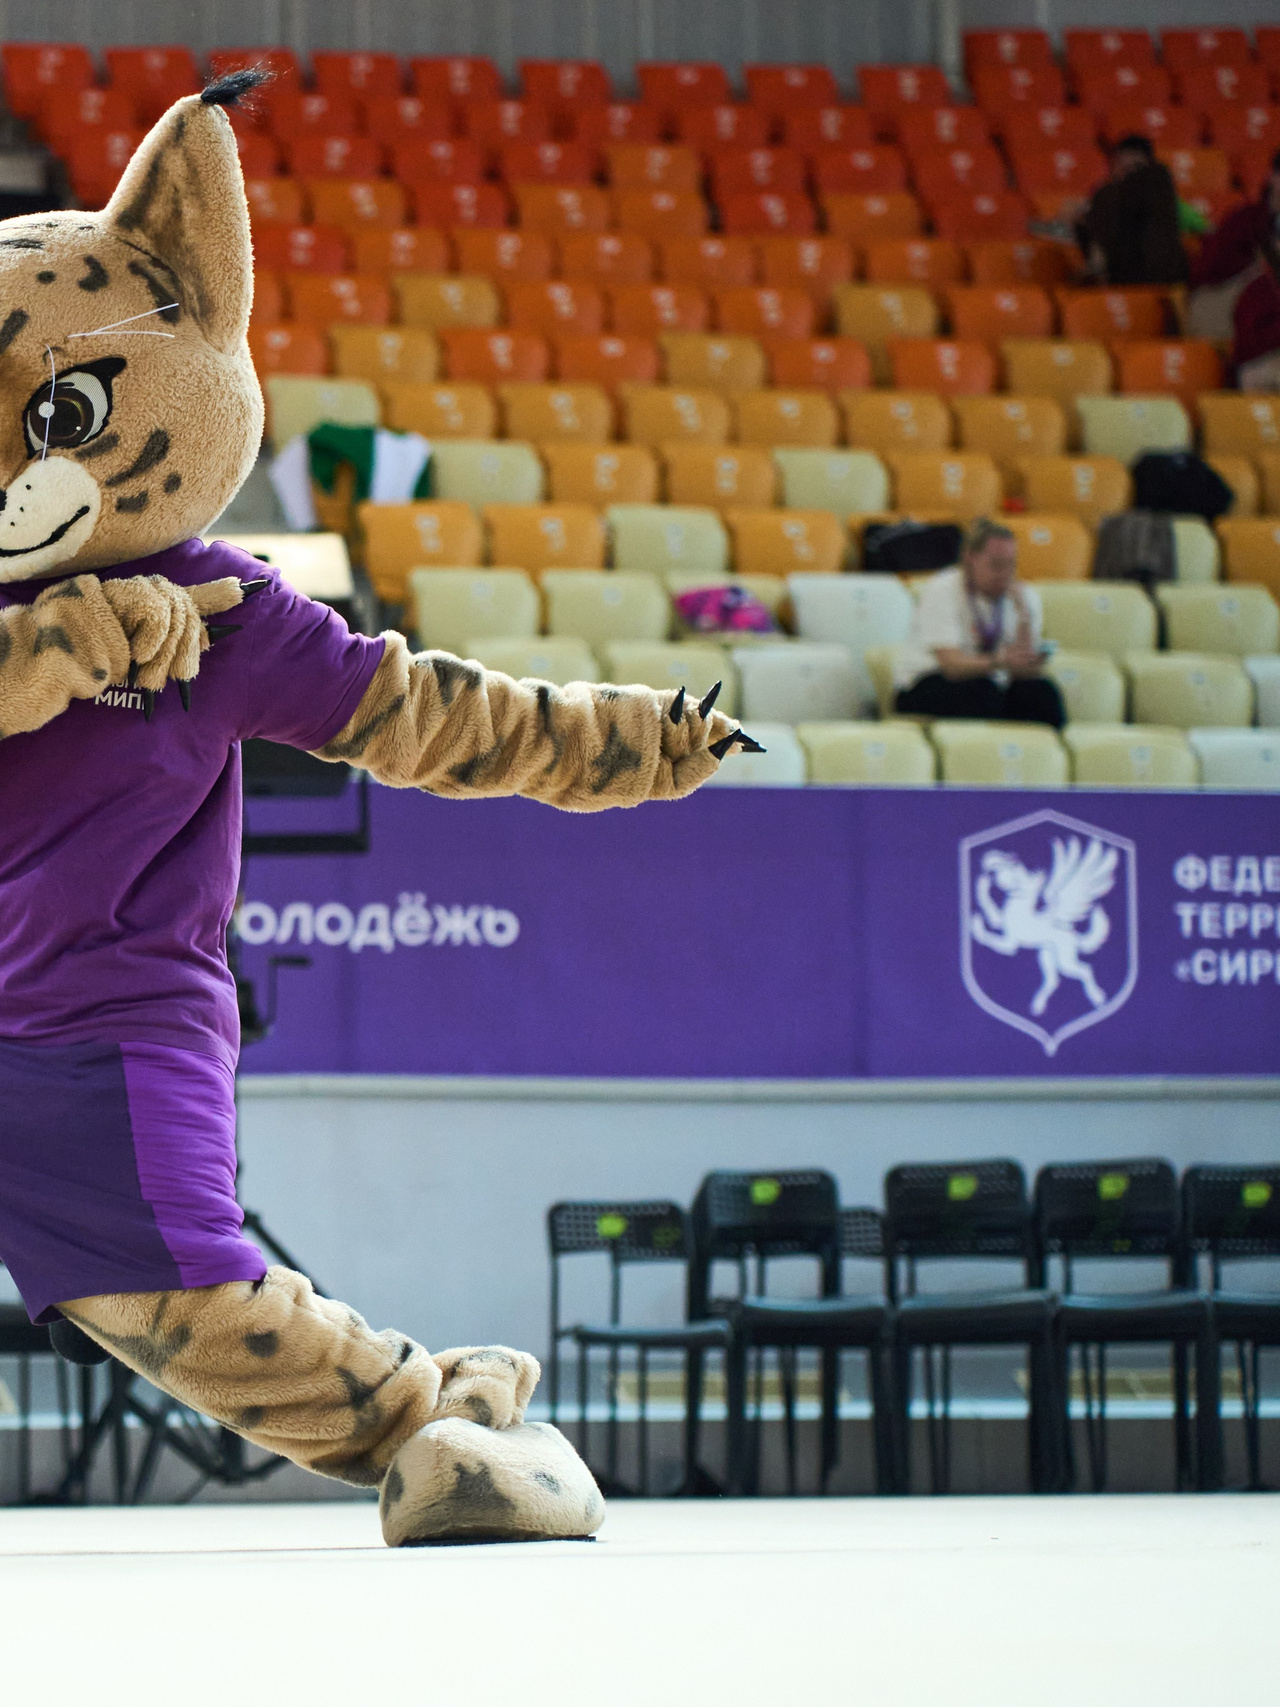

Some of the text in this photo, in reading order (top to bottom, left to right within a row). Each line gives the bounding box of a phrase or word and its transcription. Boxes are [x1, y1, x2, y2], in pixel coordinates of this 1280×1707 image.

[94, 690, 145, 711] МИП
[1173, 853, 1280, 897] ФЕДЕ
[234, 891, 520, 953] олодёжь
[1174, 902, 1280, 939] ТЕРР
[1174, 948, 1280, 986] «СИР
